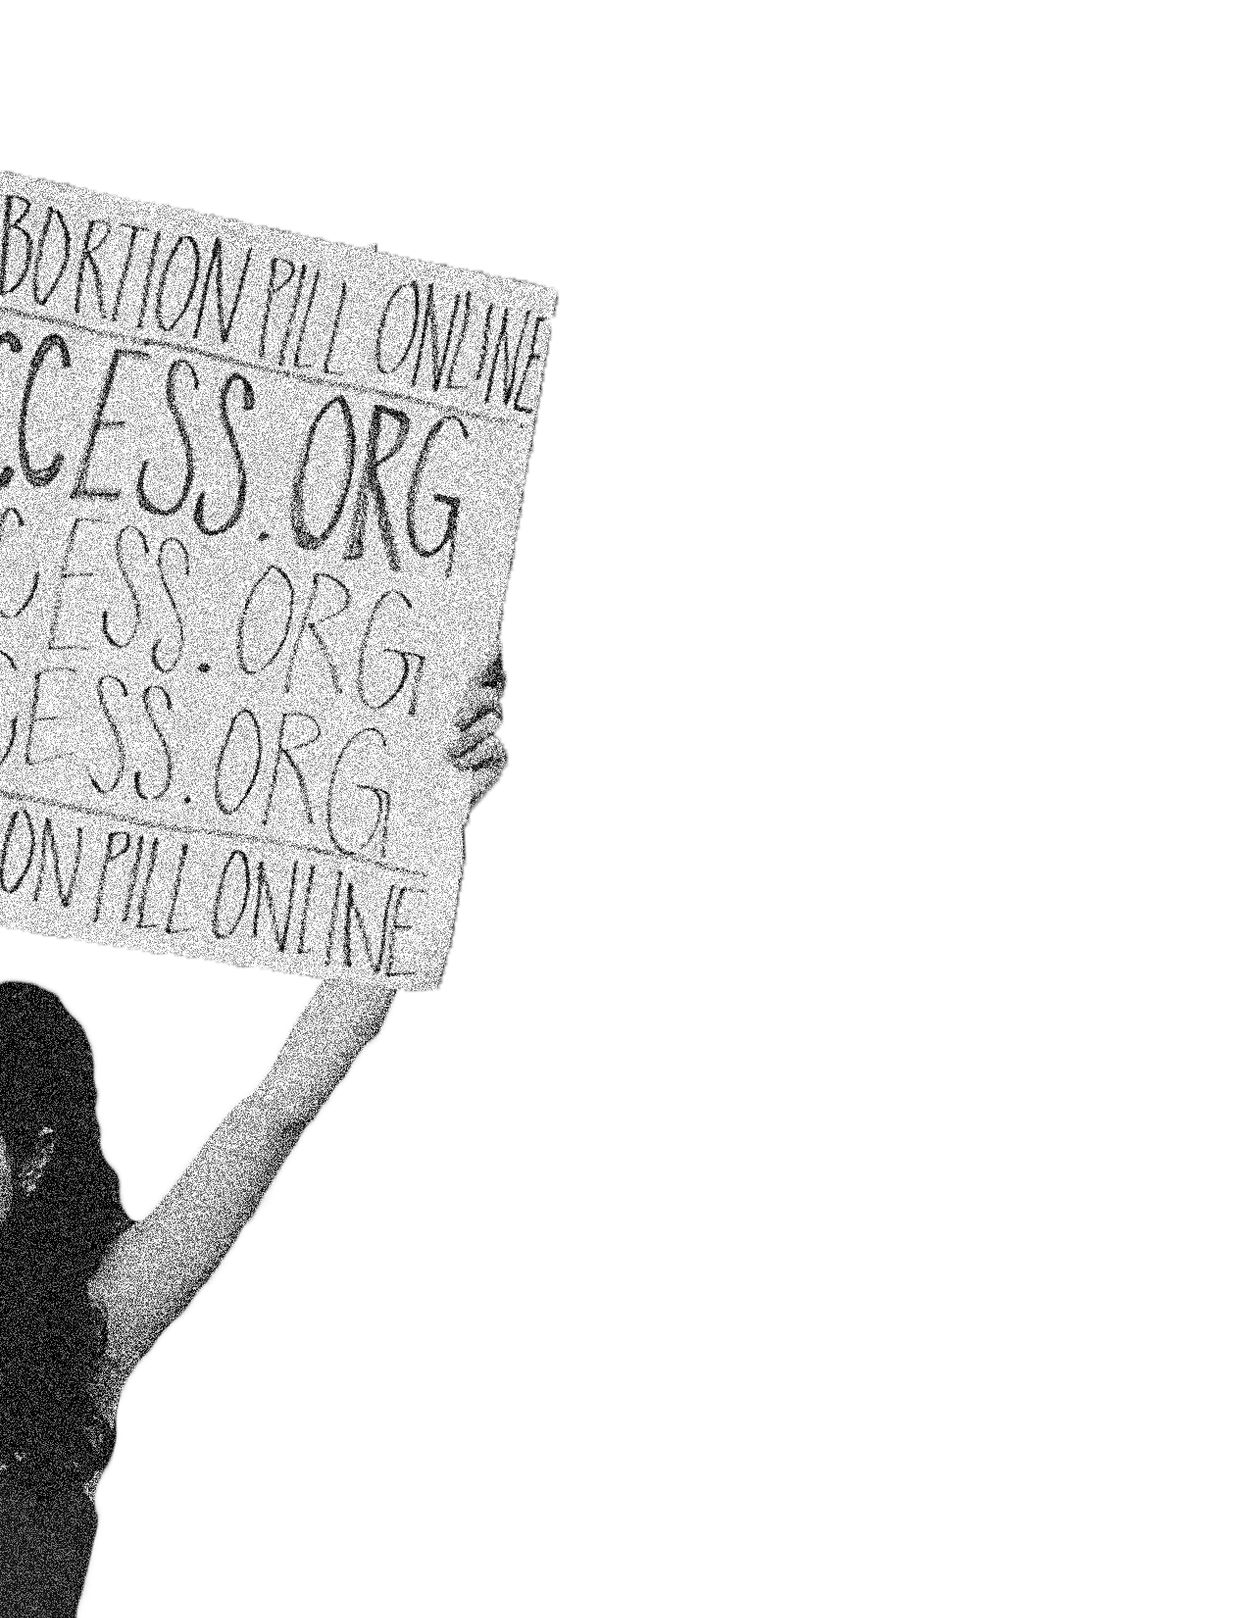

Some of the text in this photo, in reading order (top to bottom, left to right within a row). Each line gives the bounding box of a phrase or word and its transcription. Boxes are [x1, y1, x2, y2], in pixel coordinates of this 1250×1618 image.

[258, 257, 348, 375] PILL
[376, 280, 553, 413] ONLINE
[93, 830, 190, 935] PILL
[213, 850, 428, 977] ONLINE
